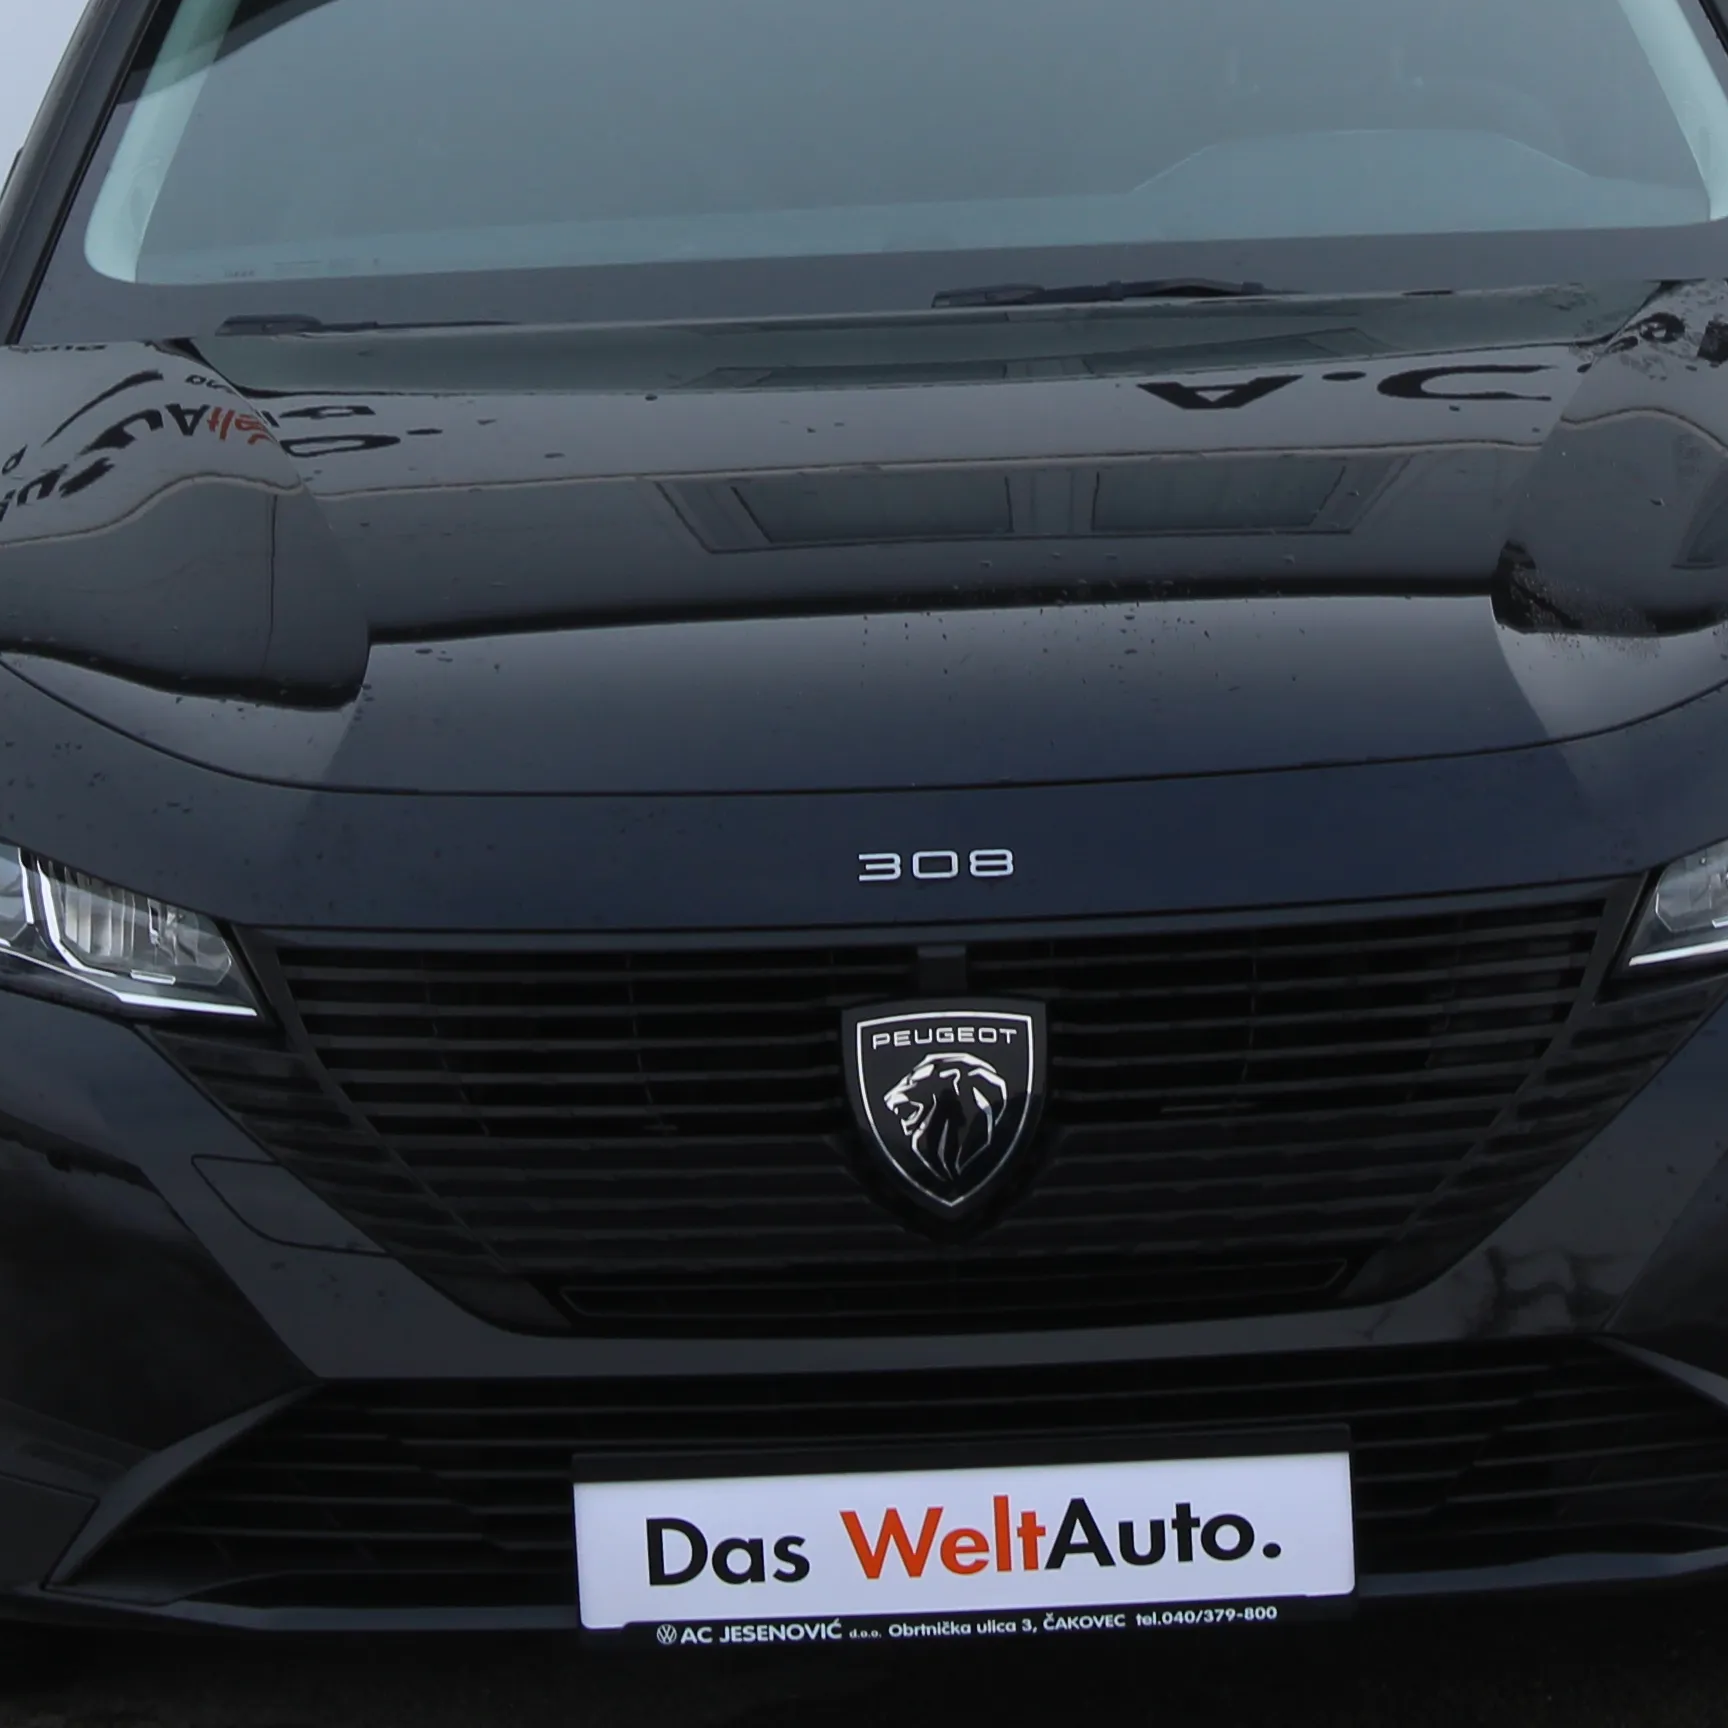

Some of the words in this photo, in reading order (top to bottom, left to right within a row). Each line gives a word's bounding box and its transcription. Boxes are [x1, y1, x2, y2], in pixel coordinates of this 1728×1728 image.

[858, 849, 1014, 881] 308
[872, 1027, 1017, 1049] PEUGEOT
[646, 1518, 810, 1586] Das
[840, 1495, 1281, 1579] WeltAuto.
[680, 1626, 713, 1644] AC
[719, 1618, 842, 1643] JESENOVIĆ
[849, 1629, 882, 1639] d.o.o.
[888, 1621, 971, 1638] Obrtnička
[976, 1619, 1016, 1634] ulica
[1022, 1618, 1038, 1634] 3,
[1043, 1612, 1126, 1631] ČAKOVEC
